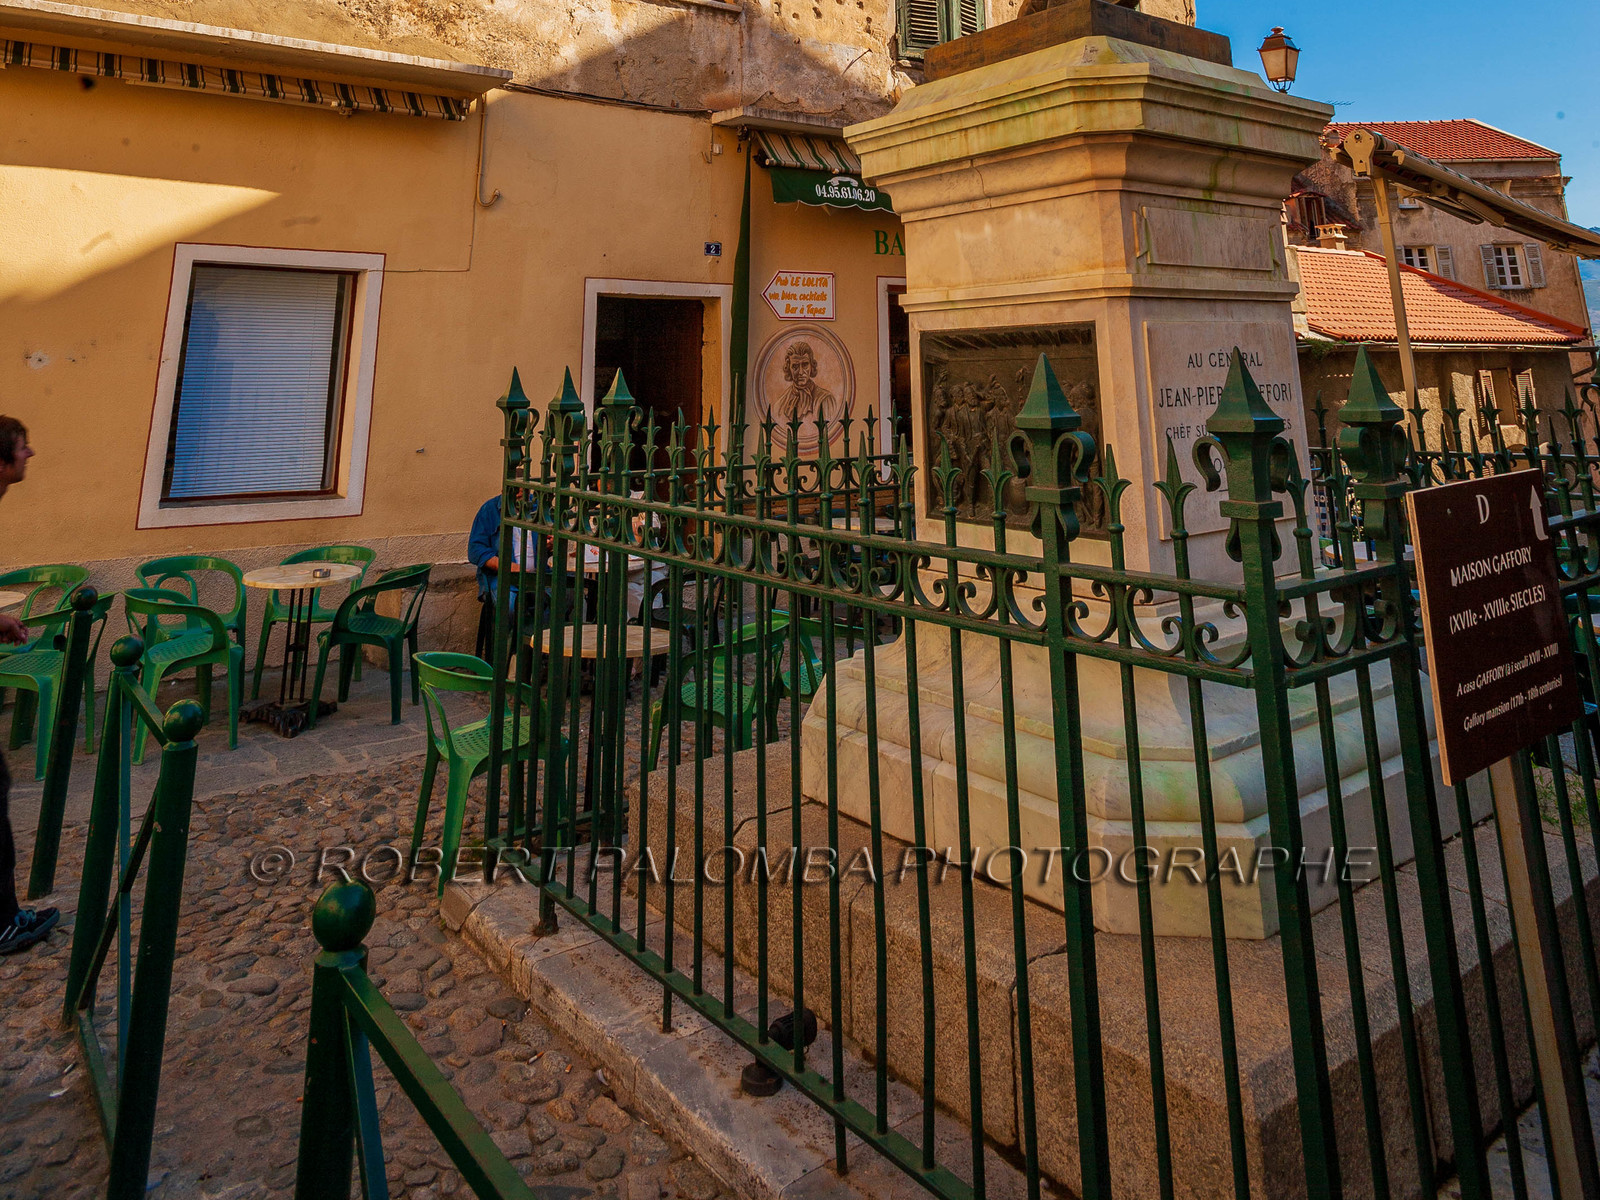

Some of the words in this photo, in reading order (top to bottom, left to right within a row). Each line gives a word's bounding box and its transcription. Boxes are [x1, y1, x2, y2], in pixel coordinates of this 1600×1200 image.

[815, 184, 876, 203] 04.95.61.06.20
[710, 244, 716, 254] 2
[775, 275, 789, 286] Pub
[784, 303, 798, 314] Bar
[807, 303, 826, 317] Tapas
[1187, 353, 1203, 368] AU
[1208, 349, 1263, 368] GÉNRAL
[1475, 494, 1490, 525] D
[1450, 557, 1492, 587] MAISON
[1492, 546, 1532, 575] GAFFORY
[1449, 608, 1478, 635] (XVIIe
[1483, 597, 1510, 622] XVIIIe
[1510, 584, 1546, 611] SIECLES)
[1456, 682, 1463, 697] A
[1463, 680, 1476, 694] casa
[1476, 664, 1504, 690] GAFFORY
[1463, 712, 1485, 732] Gaffory
[1486, 701, 1510, 721] mansion
[1510, 692, 1524, 710] (17th
[1527, 685, 1539, 701] 18th
[1539, 673, 1563, 695] centuries)
